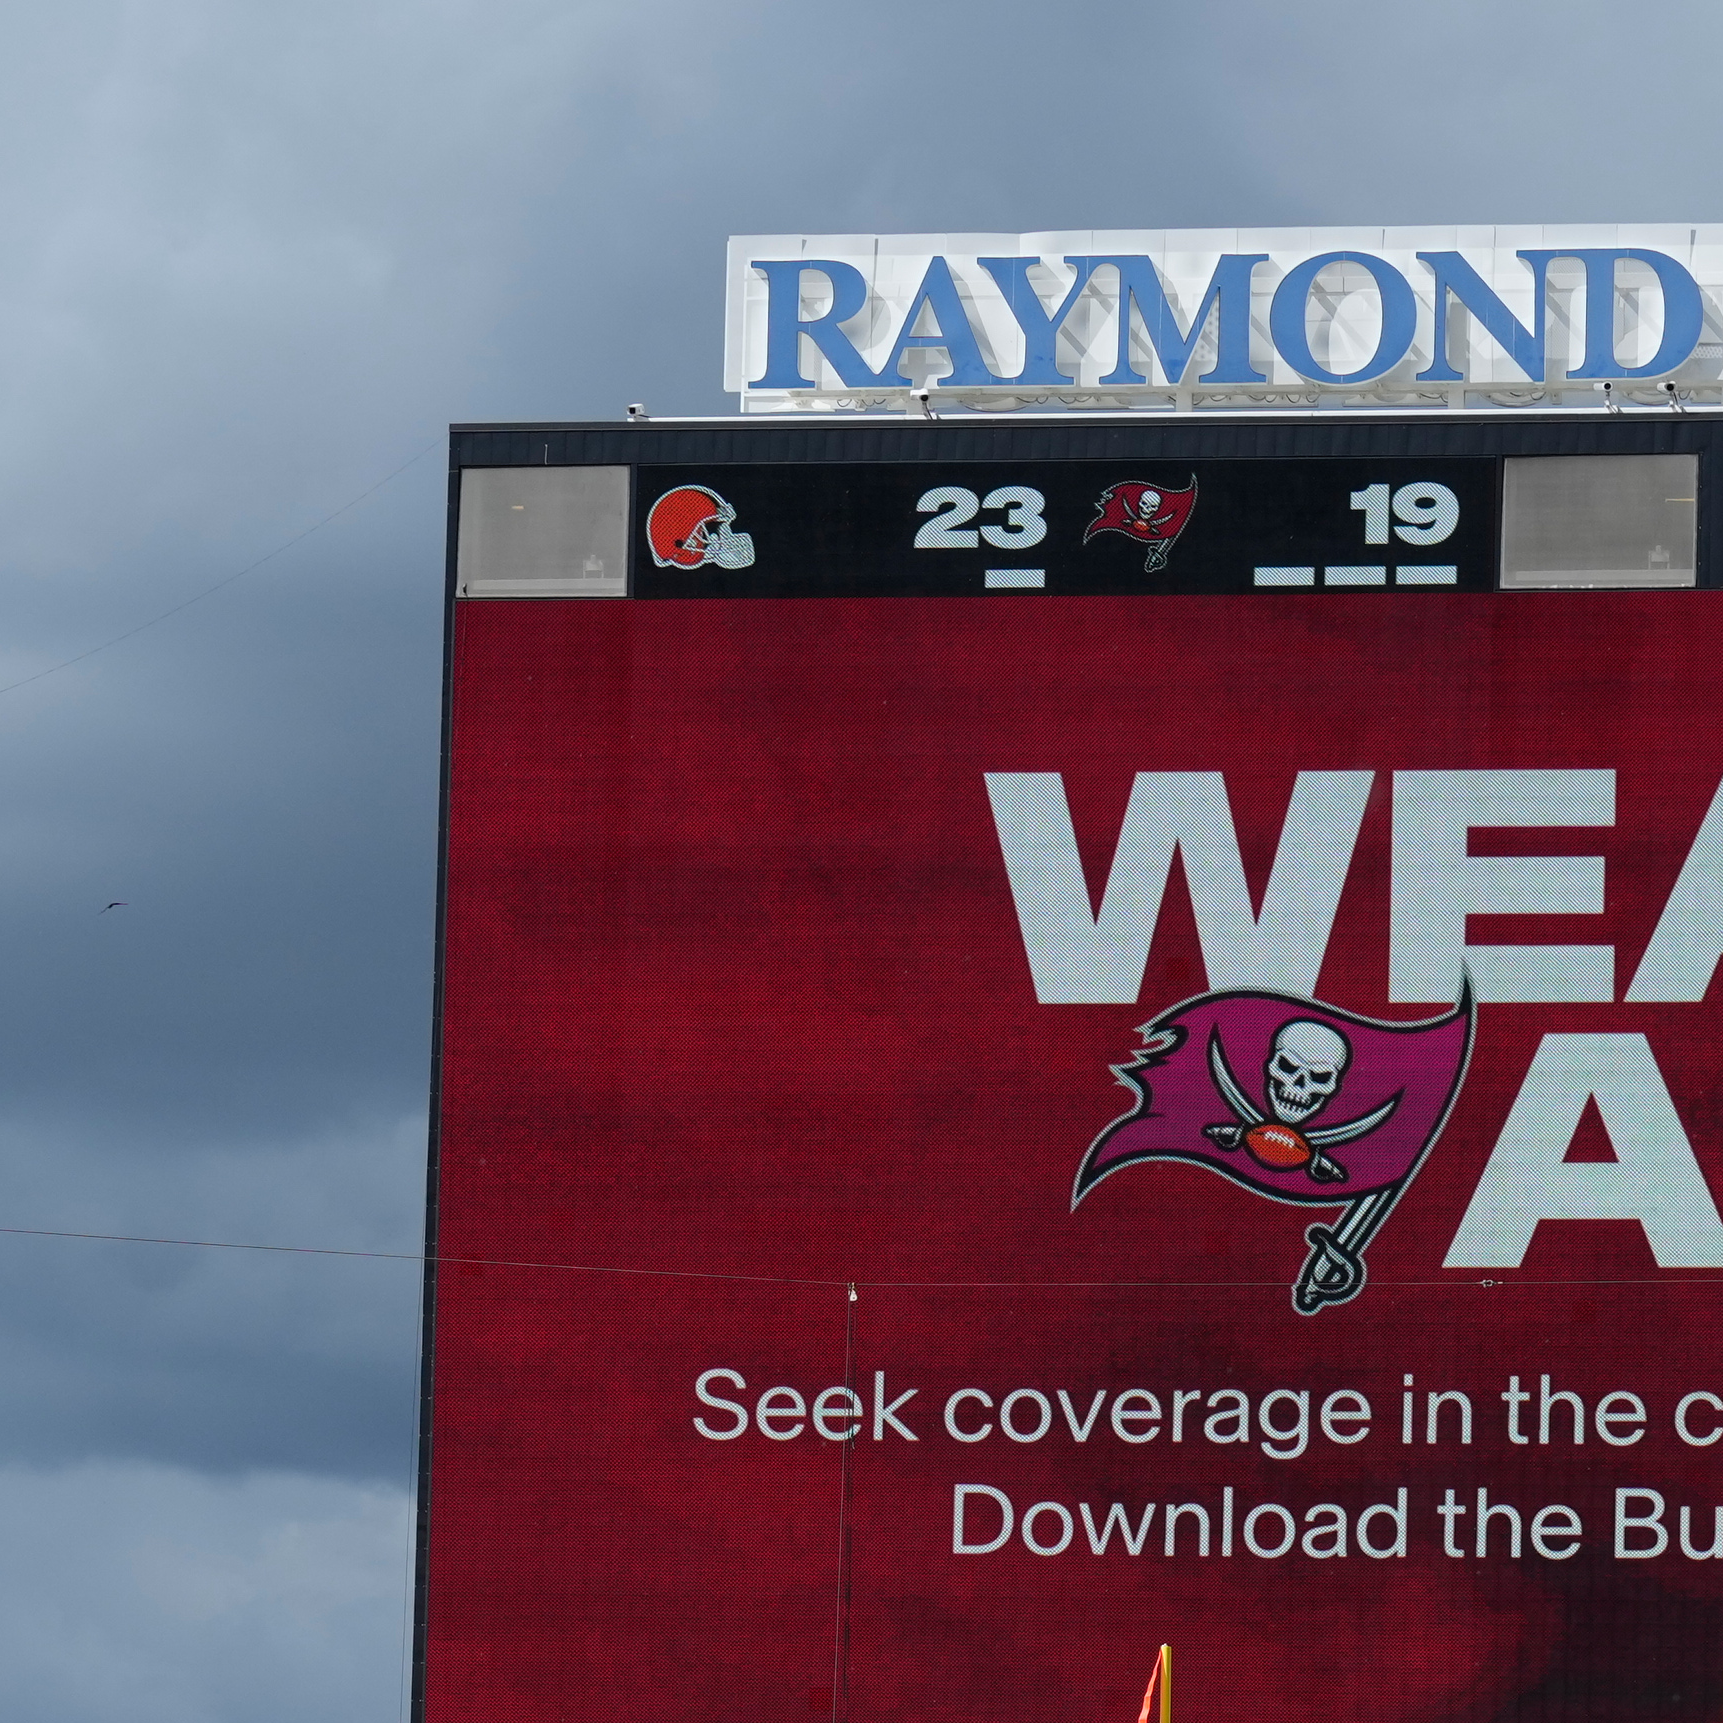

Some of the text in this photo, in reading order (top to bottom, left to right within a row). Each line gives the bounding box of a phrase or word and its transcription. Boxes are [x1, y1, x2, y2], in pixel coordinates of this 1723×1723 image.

[749, 249, 1704, 388] RAYMOND
[914, 486, 1048, 549] 23
[1350, 482, 1459, 545] 19
[693, 1368, 919, 1443] Seek
[944, 1388, 1372, 1460] coverage
[1402, 1373, 1472, 1445] in
[1501, 1374, 1647, 1447] the
[952, 1483, 1408, 1559] Download
[1436, 1487, 1583, 1560] the
